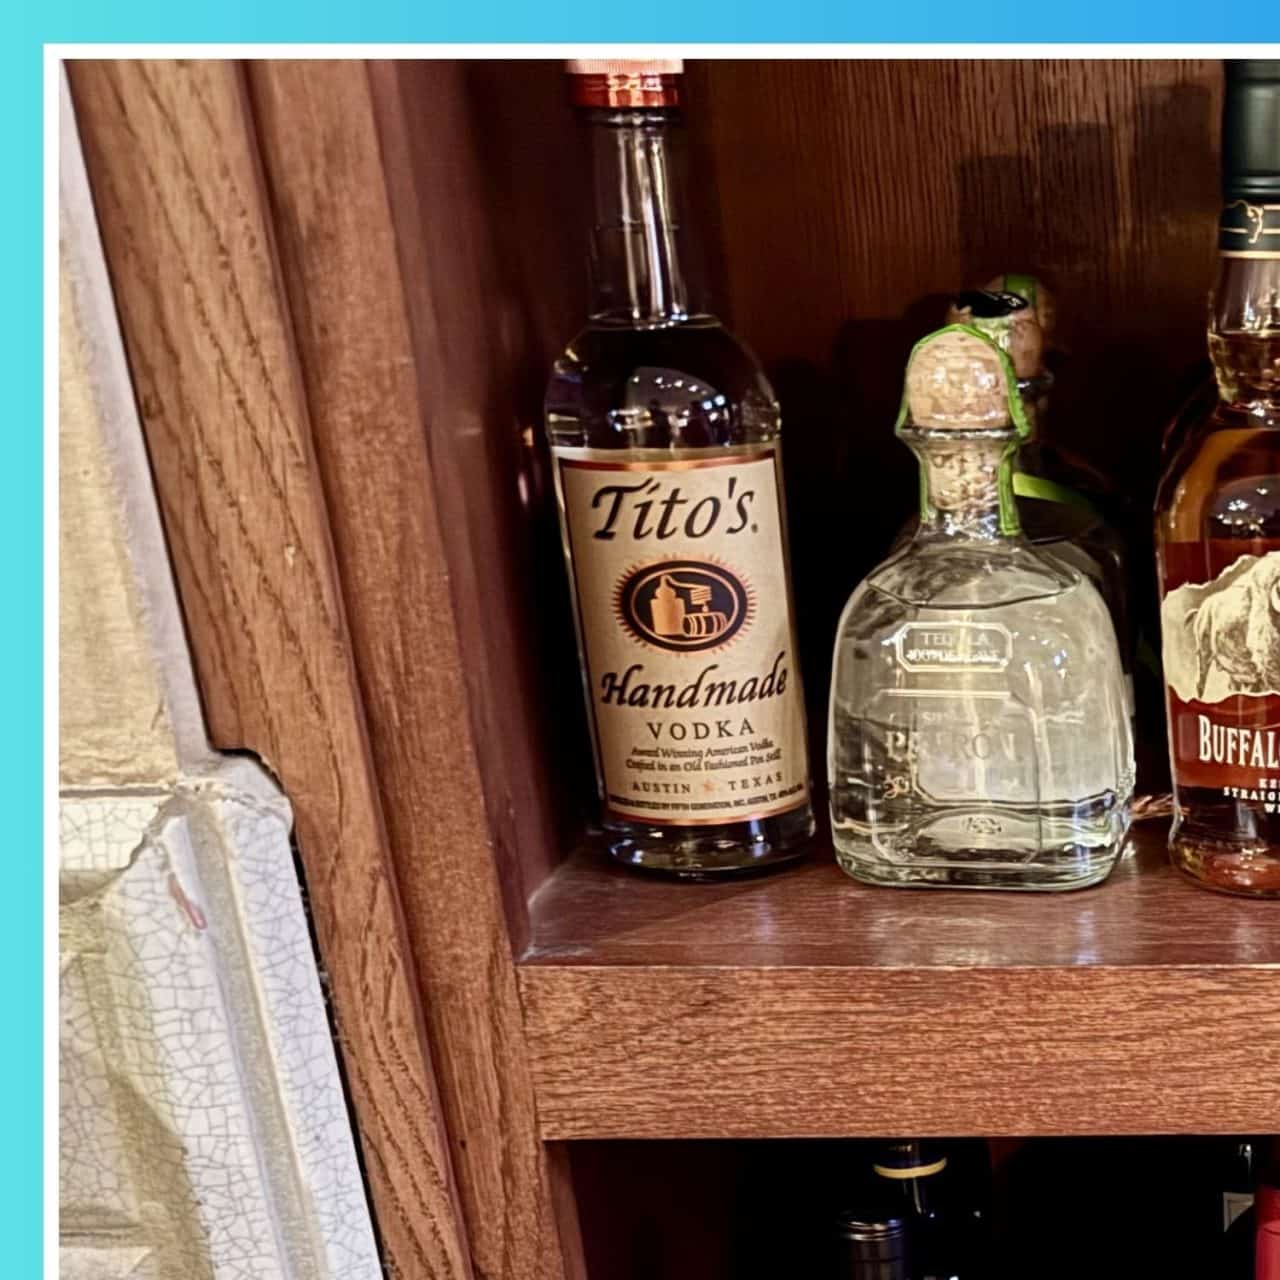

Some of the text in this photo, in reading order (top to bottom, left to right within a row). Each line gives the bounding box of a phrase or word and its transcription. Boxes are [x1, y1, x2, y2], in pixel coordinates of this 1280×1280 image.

[591, 477, 755, 541] Tito's
[600, 651, 789, 709] Handmade
[646, 717, 756, 741] VODKA
[631, 780, 692, 794] AUSTIN
[727, 771, 783, 792] TEXAS
